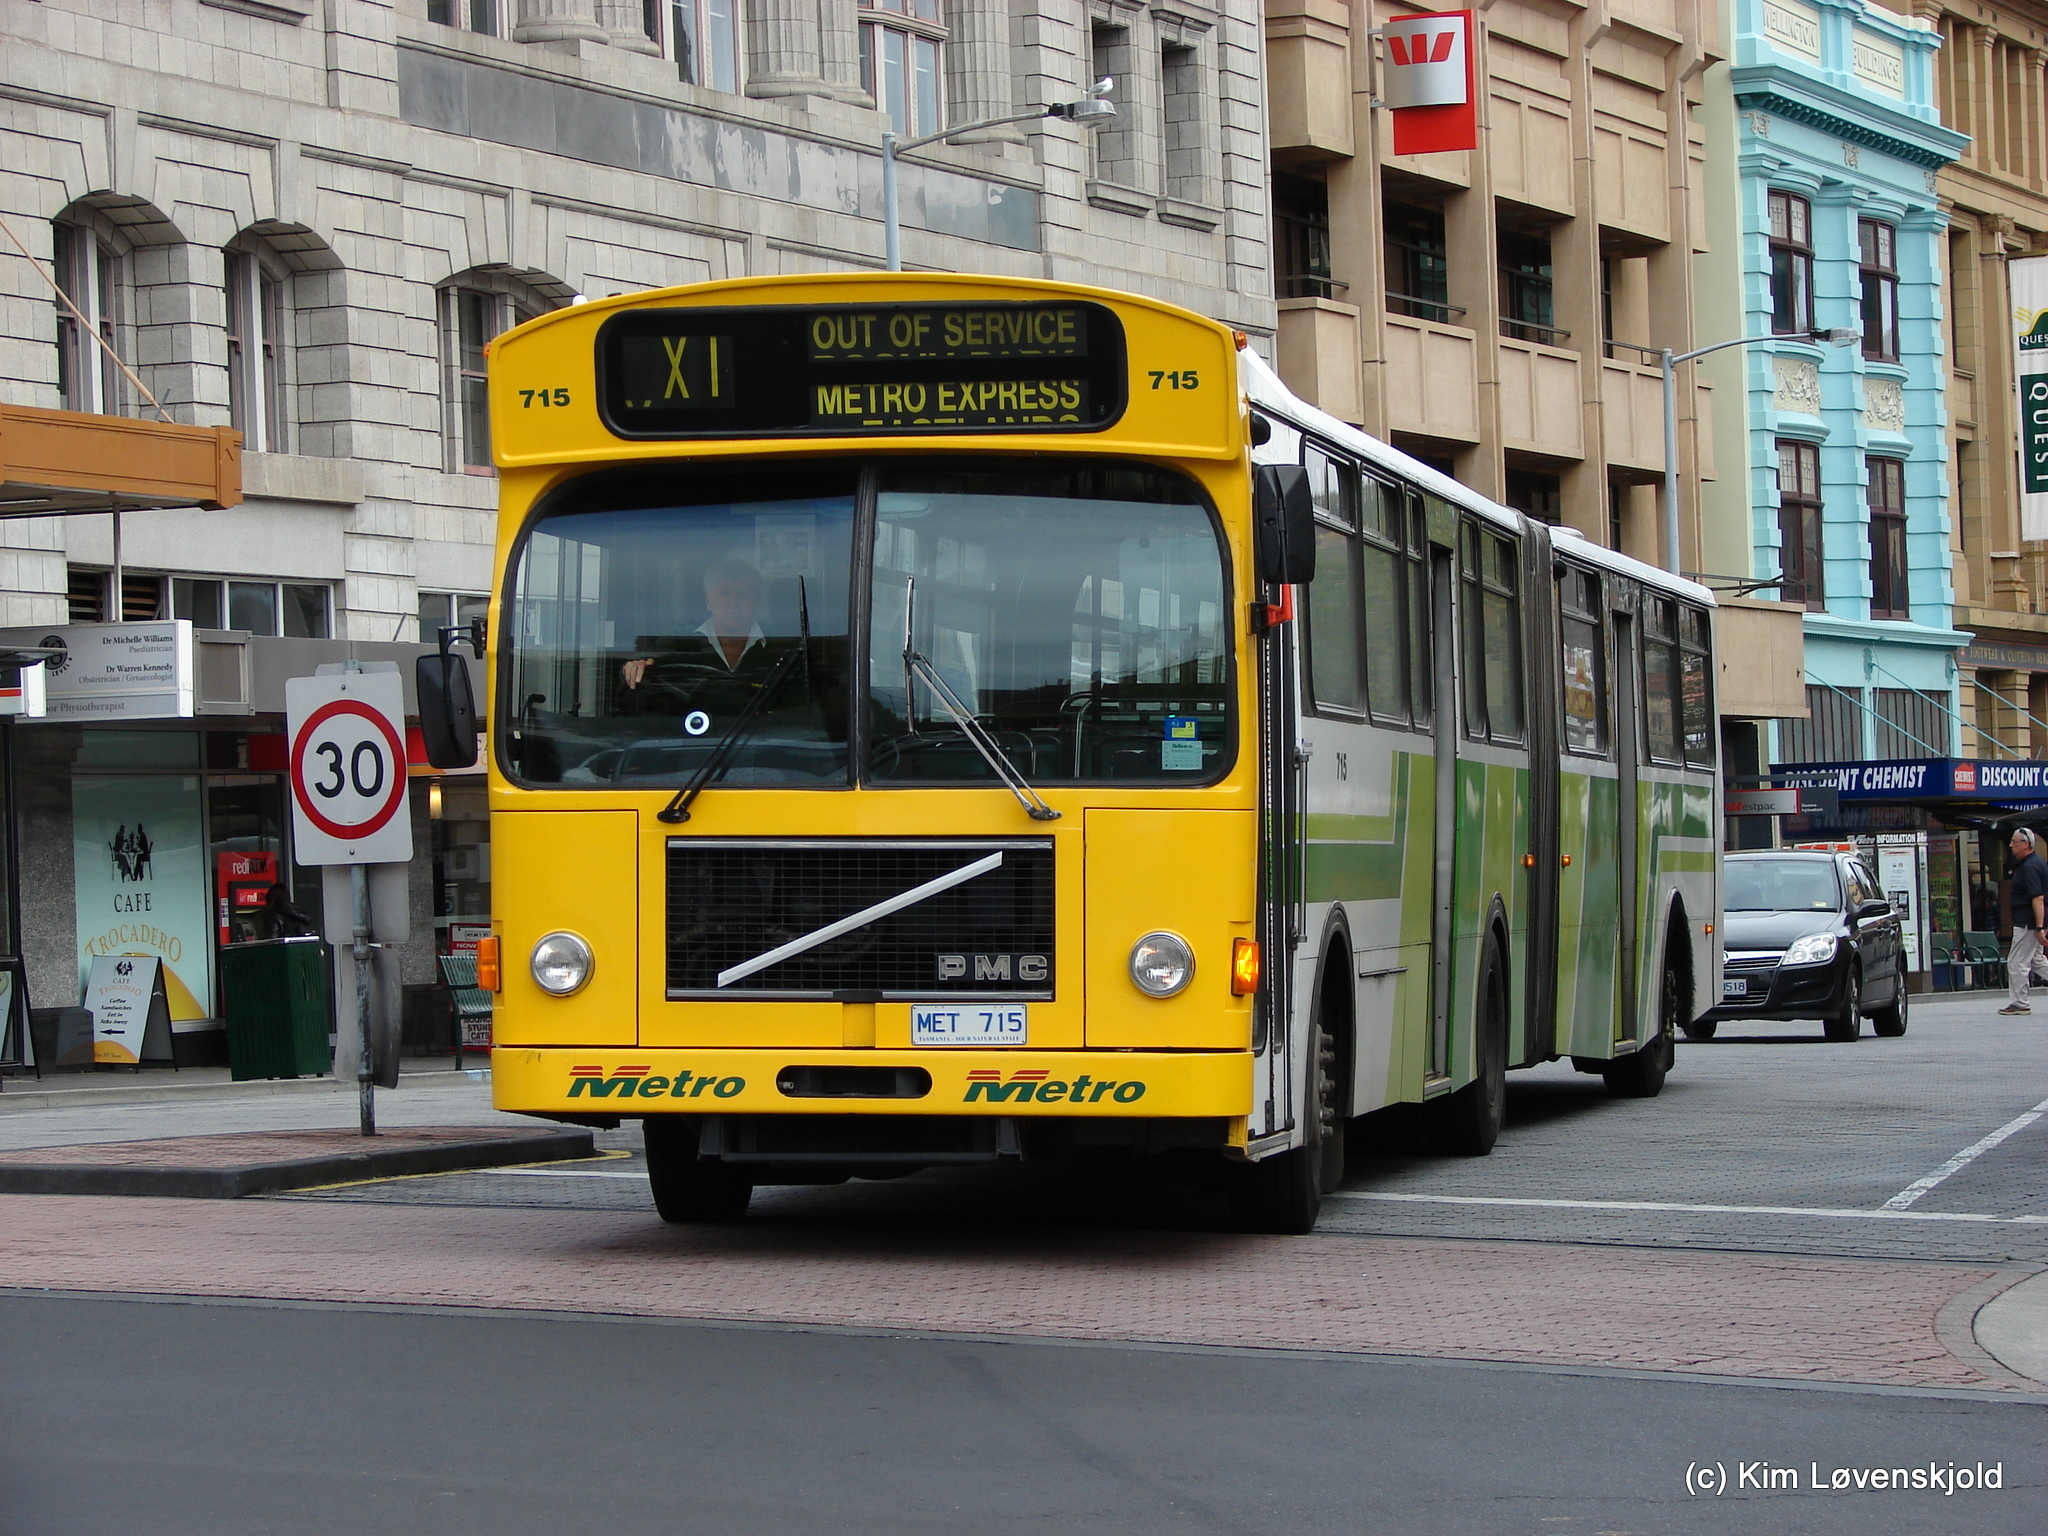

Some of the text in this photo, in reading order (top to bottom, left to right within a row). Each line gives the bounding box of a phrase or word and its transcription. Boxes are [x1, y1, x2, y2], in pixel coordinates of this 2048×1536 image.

[1763, 6, 1816, 48] WELLINGTON
[812, 309, 1077, 349] OUT OF SERVICE
[1148, 370, 1199, 390] 715
[519, 388, 571, 408] 715
[817, 380, 1080, 415] METRO EXPRESS
[103, 635, 173, 645] Dr Michelle Williams
[129, 645, 173, 654] Paediatrician
[78, 675, 120, 684] Obstetrician
[126, 673, 173, 683] Gynaecologist
[117, 665, 142, 673] Warren
[143, 663, 173, 673] Kennedy
[60, 702, 125, 714] Physiotherapist
[315, 740, 384, 798] 30
[1336, 752, 1347, 781] 715
[1981, 766, 2040, 787] DISCOUNT
[1863, 765, 1926, 790] CHEMIST
[1877, 833, 1916, 844] INFORMATION
[114, 893, 151, 912] CAFE
[85, 923, 182, 962] TROCADERO
[938, 954, 1048, 981] PMC
[917, 1012, 1022, 1033] MET 715
[566, 1065, 746, 1099] Metro
[963, 1069, 1147, 1103] Metro
